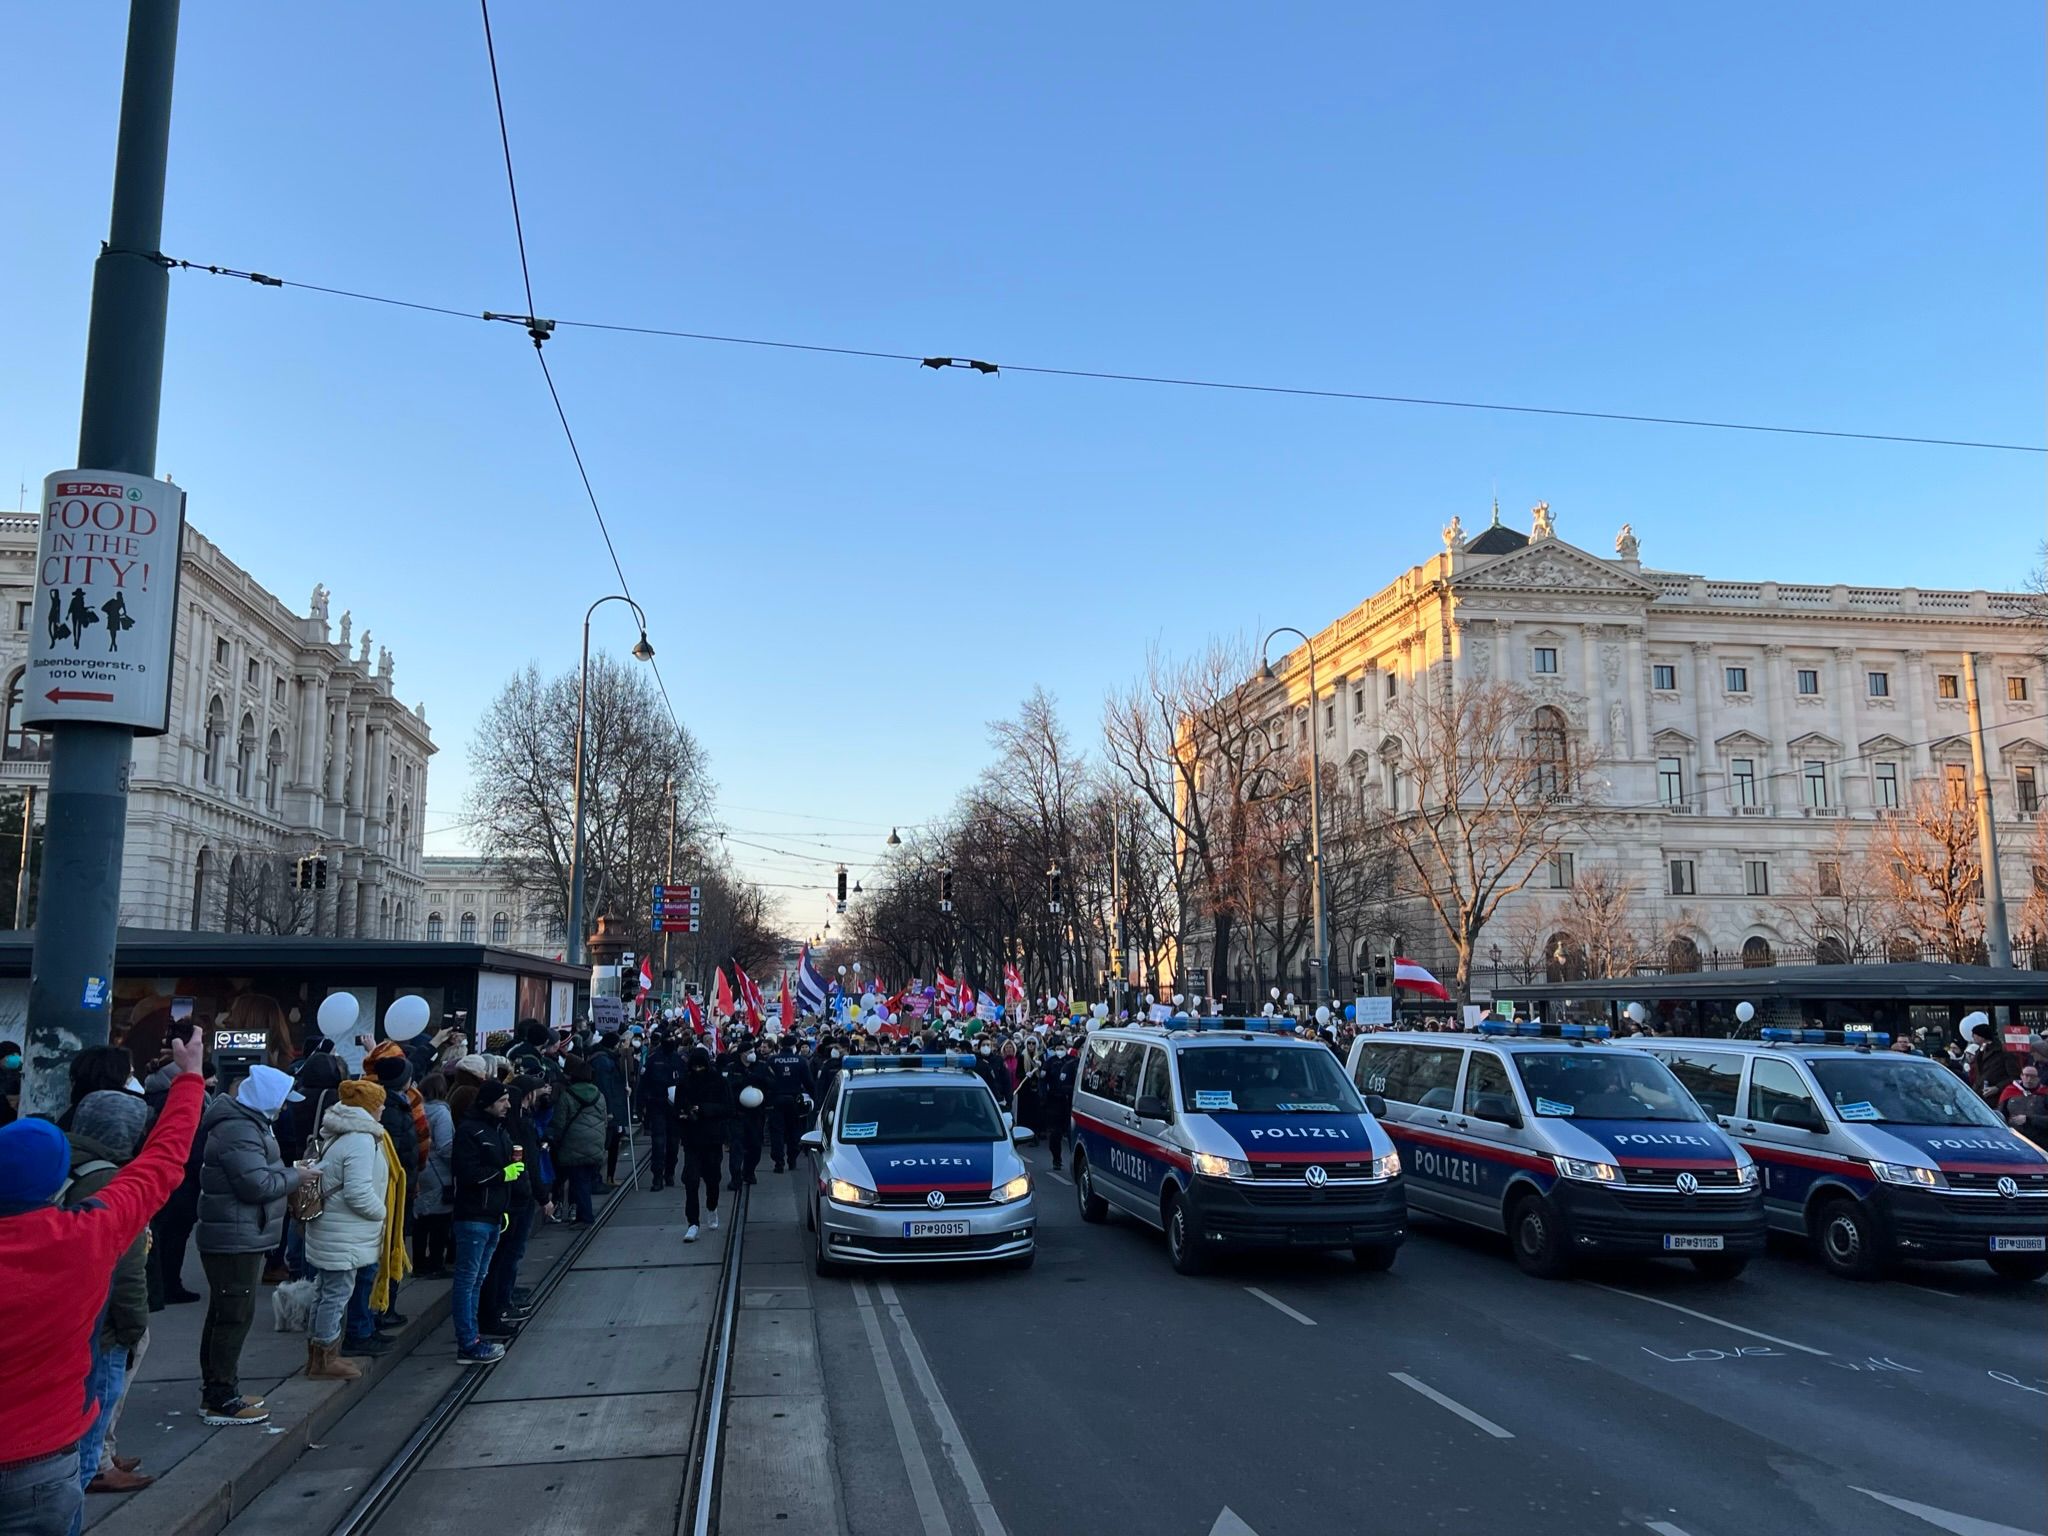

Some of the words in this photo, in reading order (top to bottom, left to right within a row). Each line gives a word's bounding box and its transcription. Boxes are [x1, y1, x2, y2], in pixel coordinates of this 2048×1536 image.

[66, 484, 122, 497] SPAR
[47, 499, 157, 536] FOOD
[52, 533, 75, 552] IN
[83, 533, 140, 557] THE
[137, 664, 146, 673] 9
[49, 670, 77, 679] 1010
[81, 670, 116, 681] Wien
[829, 997, 853, 1009] 220
[597, 1016, 619, 1024] STURM
[1852, 1024, 1872, 1032] CASH
[1374, 1077, 1386, 1092] 133
[1250, 1127, 1350, 1139] POLIZEI
[1614, 1134, 1711, 1146] POLIZEI
[1927, 1138, 2021, 1151] POLIZEI
[889, 1158, 971, 1167] POLIZEI
[1110, 1147, 1147, 1183] POLIZEI
[1415, 1149, 1478, 1185] POLIZEI
